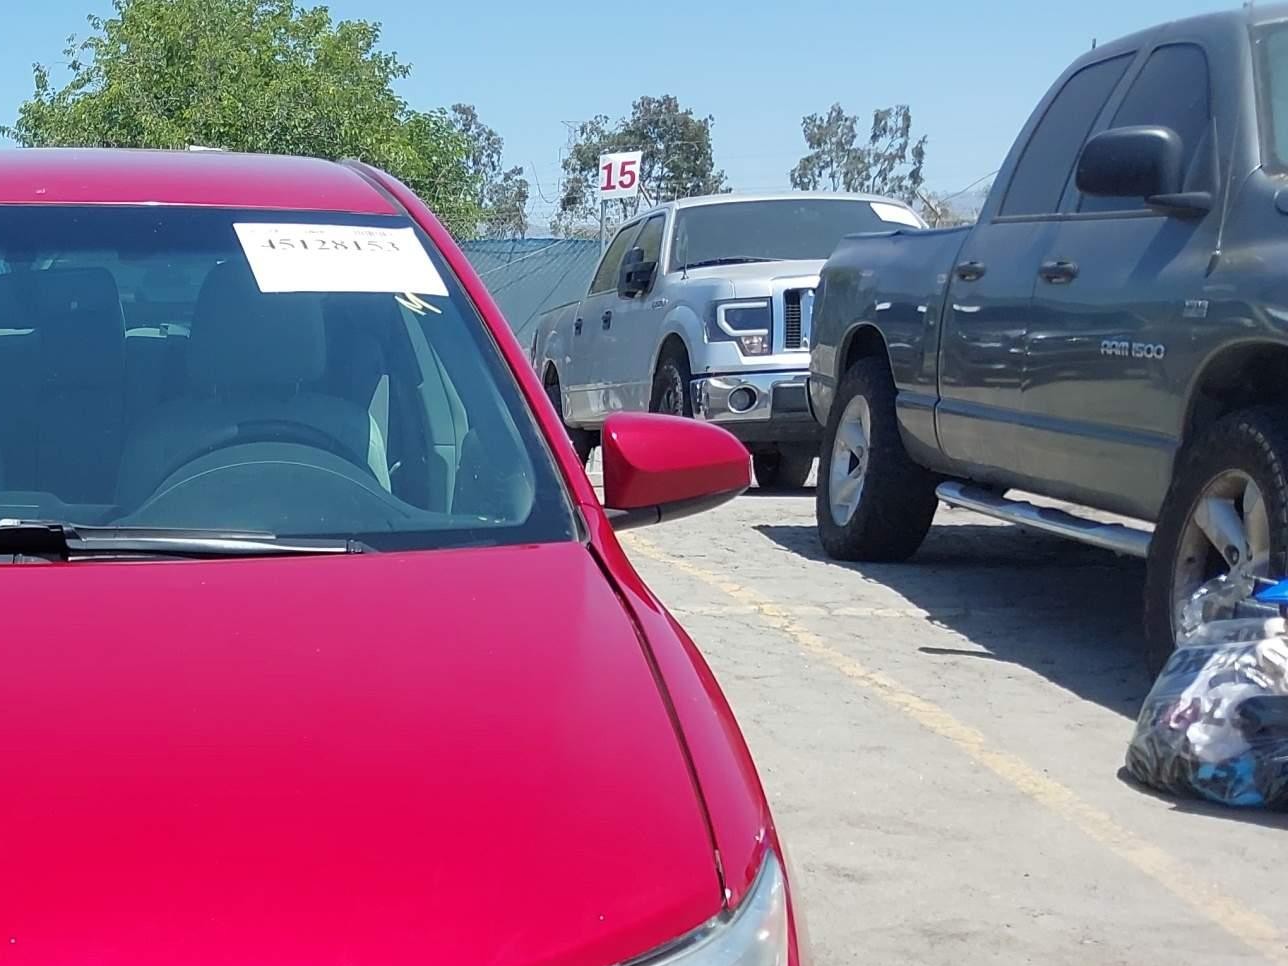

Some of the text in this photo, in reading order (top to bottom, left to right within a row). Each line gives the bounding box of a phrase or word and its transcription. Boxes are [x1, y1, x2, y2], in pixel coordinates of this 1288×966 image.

[600, 160, 637, 191] 15
[1100, 339, 1165, 359] RAM 1500
